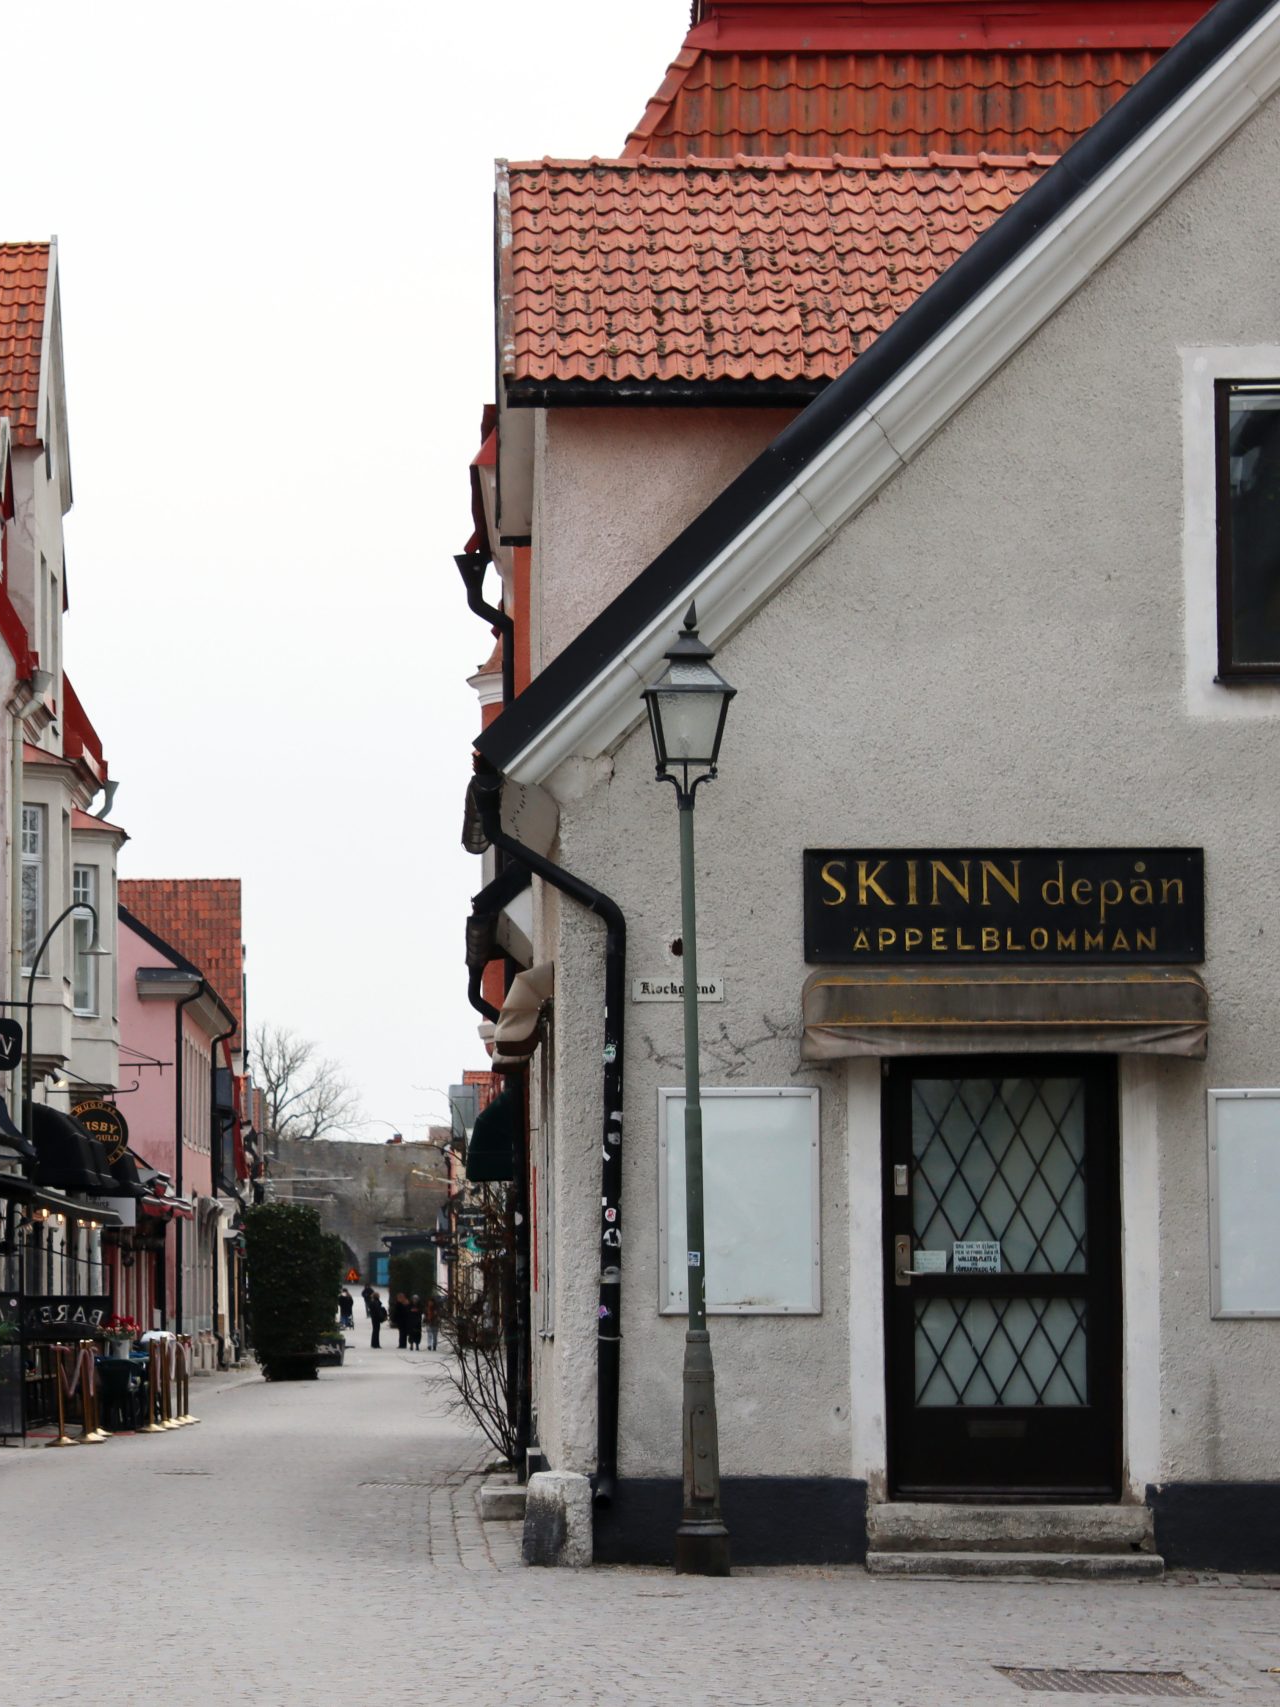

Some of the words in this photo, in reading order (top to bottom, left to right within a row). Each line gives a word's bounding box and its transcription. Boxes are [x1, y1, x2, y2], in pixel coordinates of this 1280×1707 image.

[821, 860, 1021, 907] SKINN
[1041, 860, 1185, 924] depån
[853, 926, 1158, 952] ÄPPELBLOMMAN
